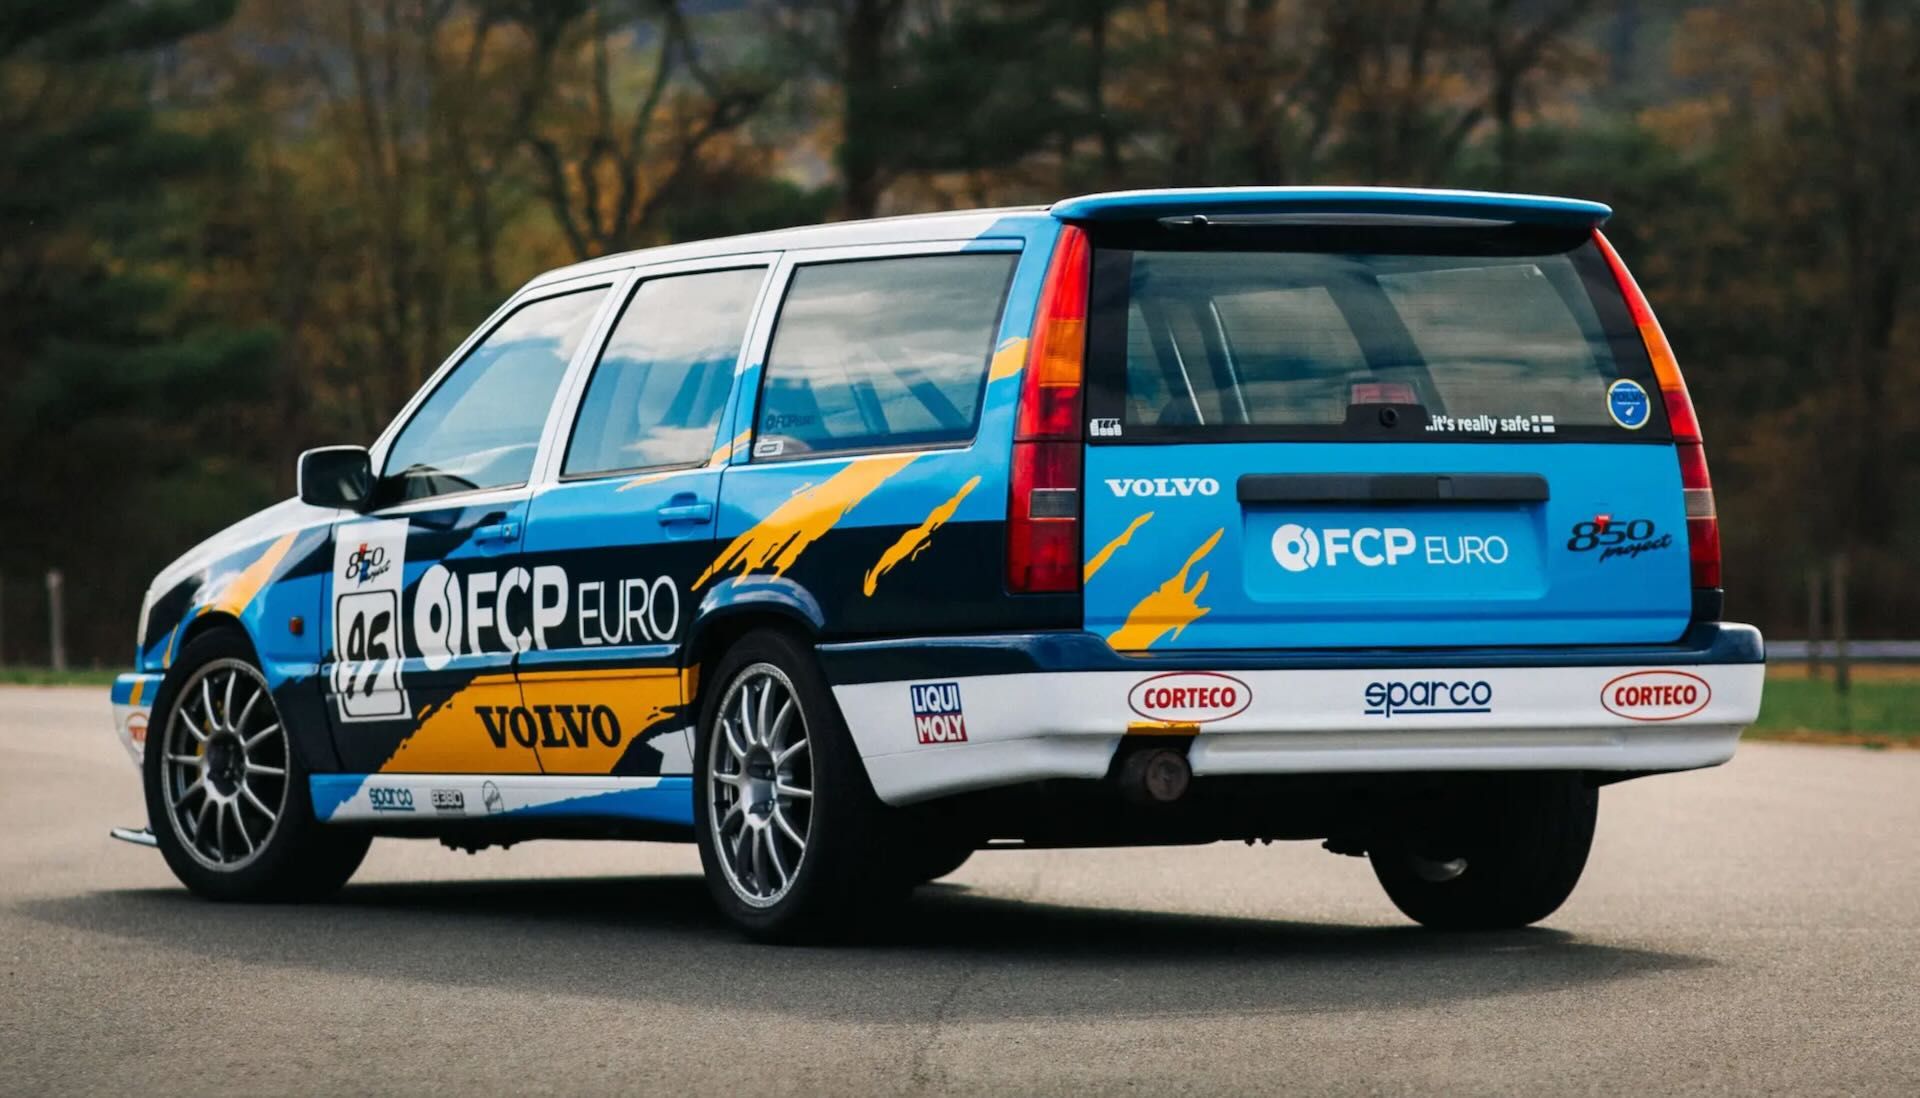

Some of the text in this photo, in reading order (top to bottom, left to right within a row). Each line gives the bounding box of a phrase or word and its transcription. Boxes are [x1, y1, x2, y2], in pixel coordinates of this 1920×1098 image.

[1458, 414, 1497, 435] really
[1501, 415, 1530, 431] safe
[1104, 478, 1220, 497] VOLVO
[1323, 527, 1508, 566] FCP EURO
[1567, 519, 1655, 552] 850
[1599, 533, 1672, 562] project
[345, 546, 384, 579] 850
[468, 565, 679, 656] FCP EURO
[912, 685, 960, 713] LIQUI
[1144, 687, 1237, 709] CORTECO
[1365, 680, 1492, 718] sparco
[1614, 684, 1698, 707] CORTECO
[475, 704, 622, 748] VOLVO
[916, 715, 963, 742] MOLY
[369, 787, 415, 813] sparco
